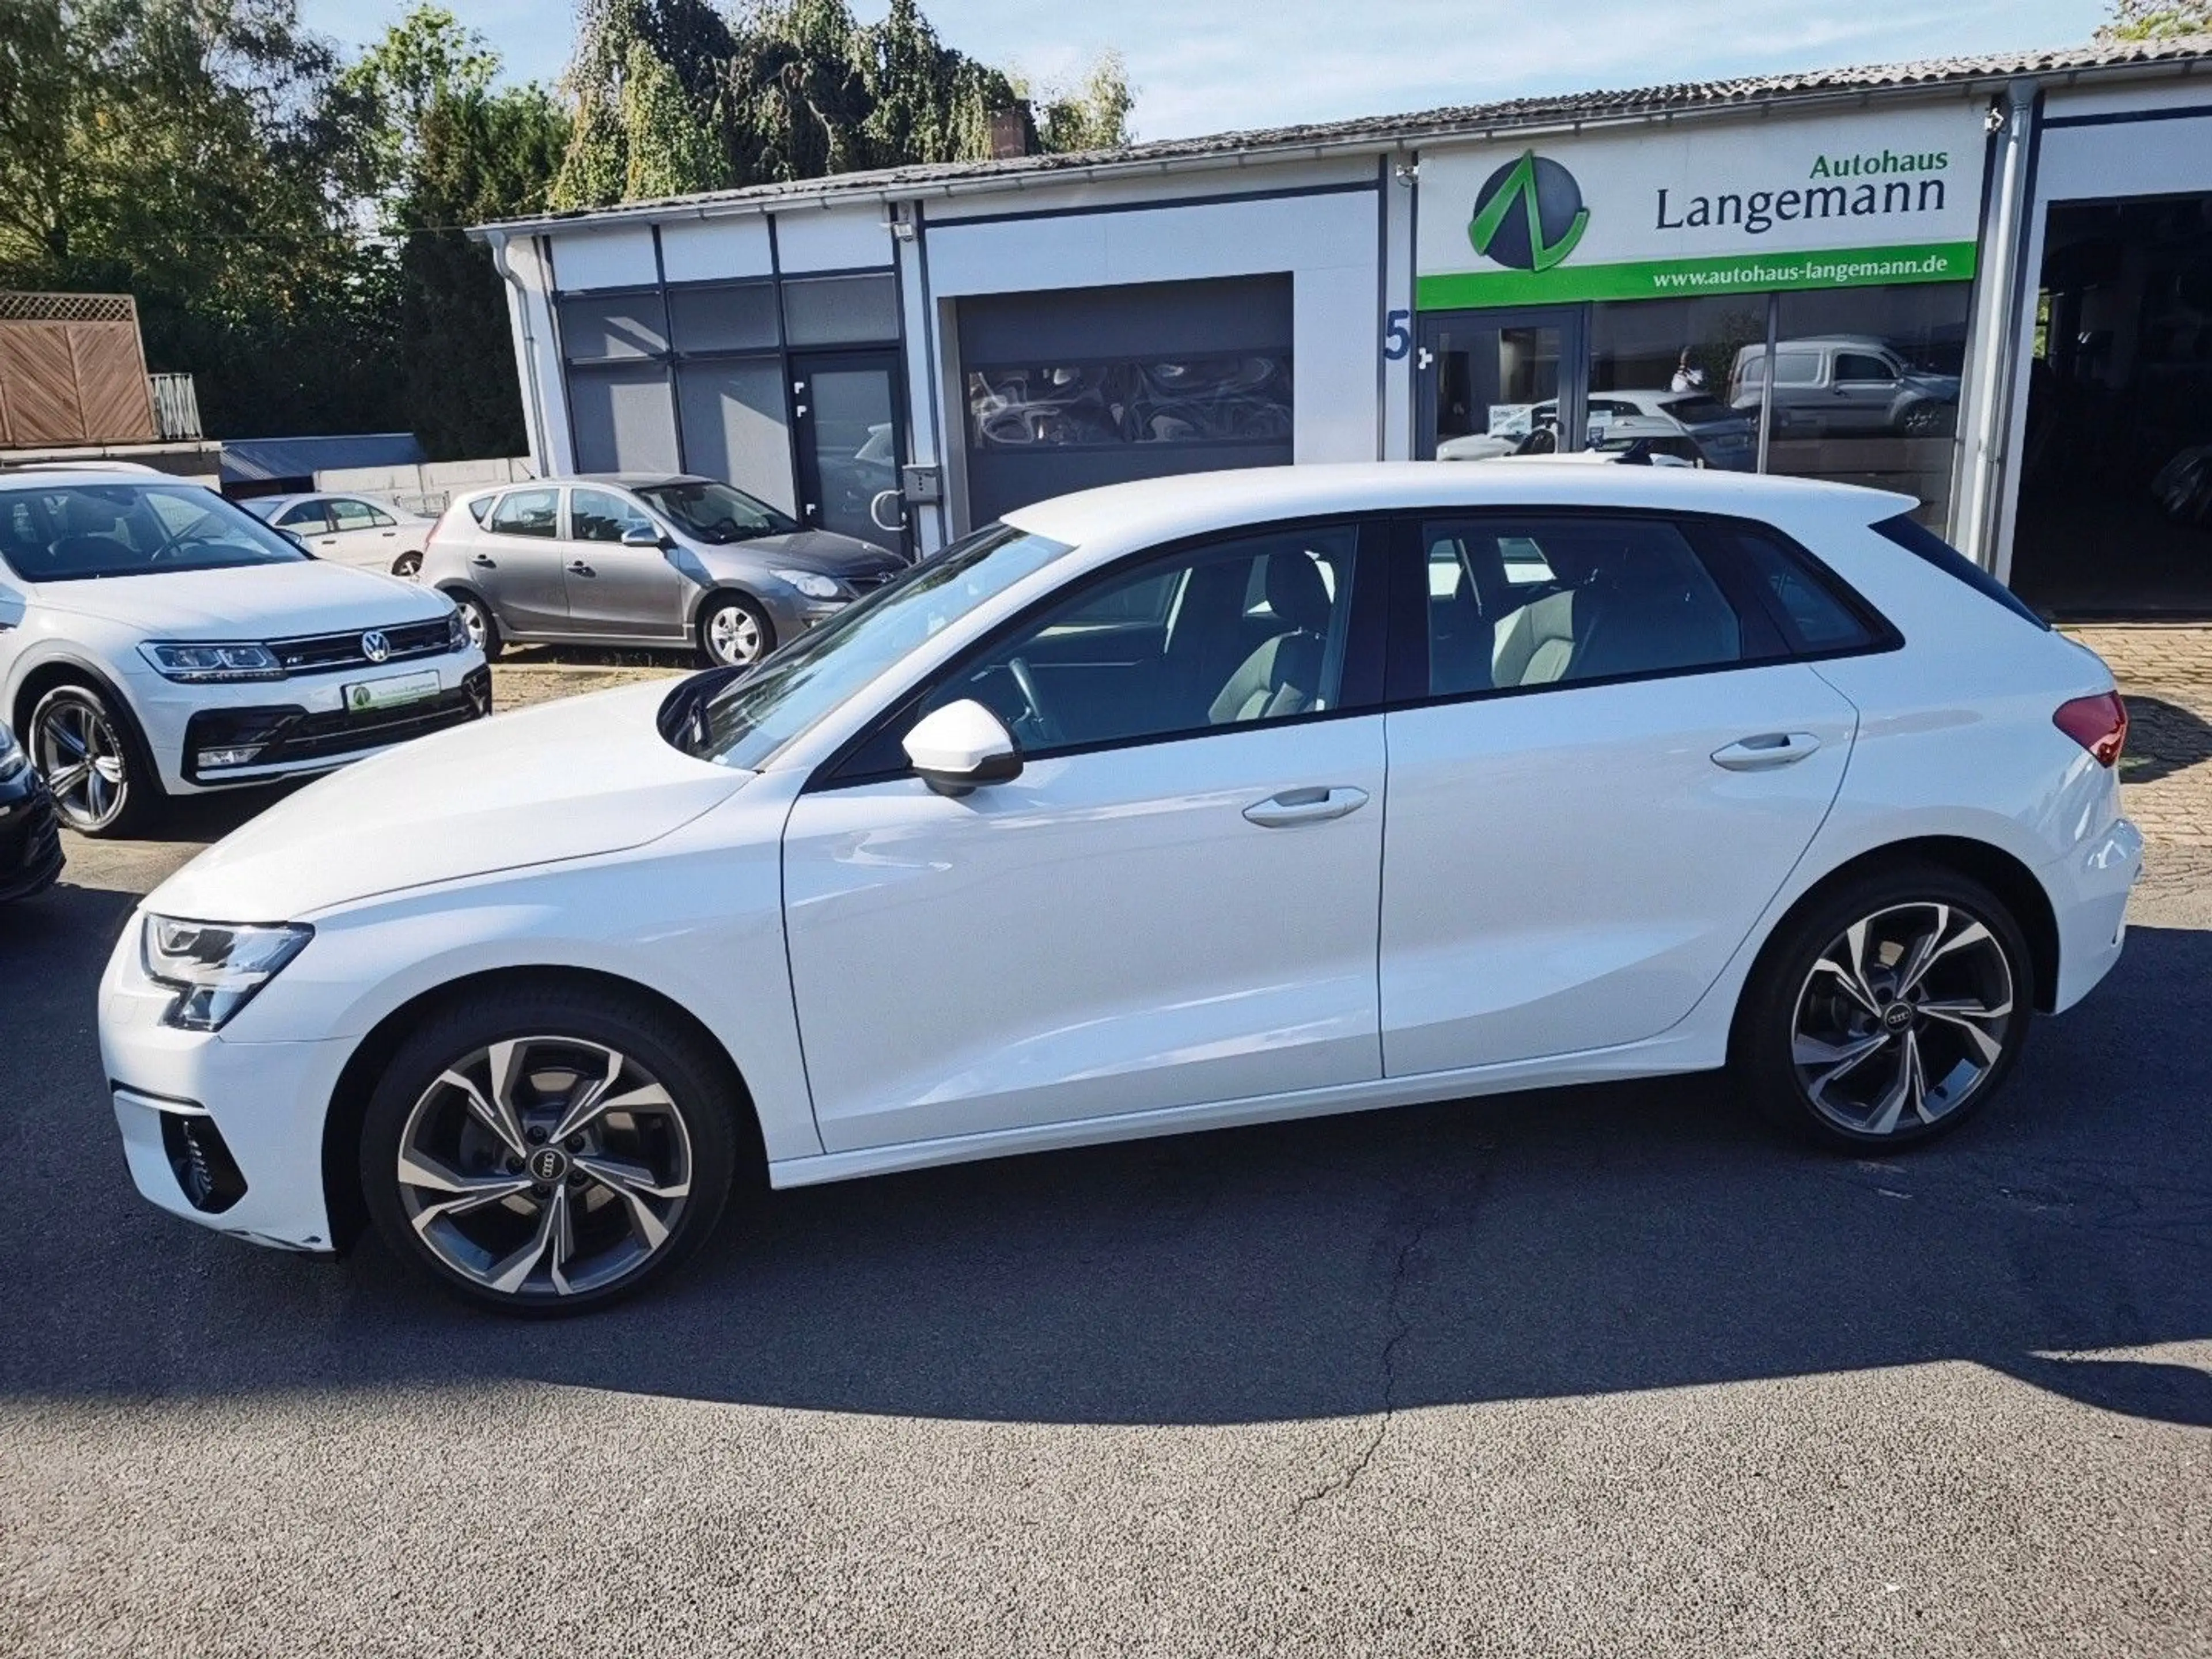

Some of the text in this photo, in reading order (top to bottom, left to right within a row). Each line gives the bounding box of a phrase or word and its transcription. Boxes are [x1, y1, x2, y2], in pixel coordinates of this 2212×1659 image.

[1809, 149, 1948, 179] Autohaus
[1656, 179, 1946, 234] Langemann
[1653, 255, 1948, 287] www.autohaus-langemann.de
[1382, 309, 1411, 360] 5
